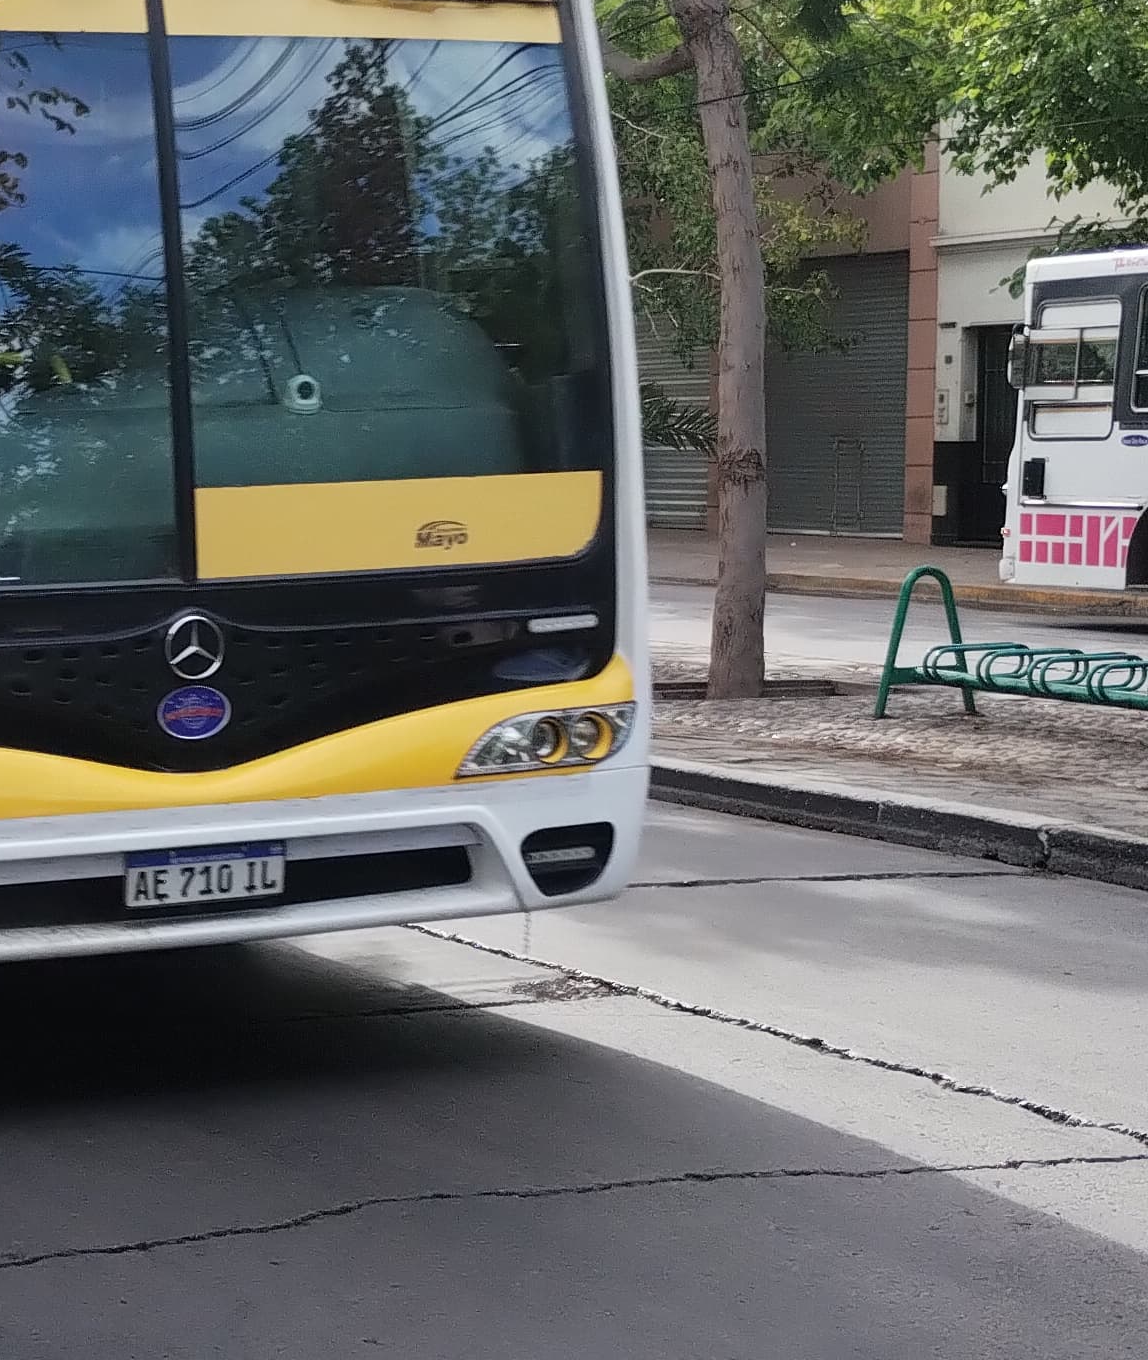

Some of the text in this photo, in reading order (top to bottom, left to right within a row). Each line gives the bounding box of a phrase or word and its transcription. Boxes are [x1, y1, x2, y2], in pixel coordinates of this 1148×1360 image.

[414, 532, 468, 550] Mayo
[133, 860, 278, 901] AE 710 IL
